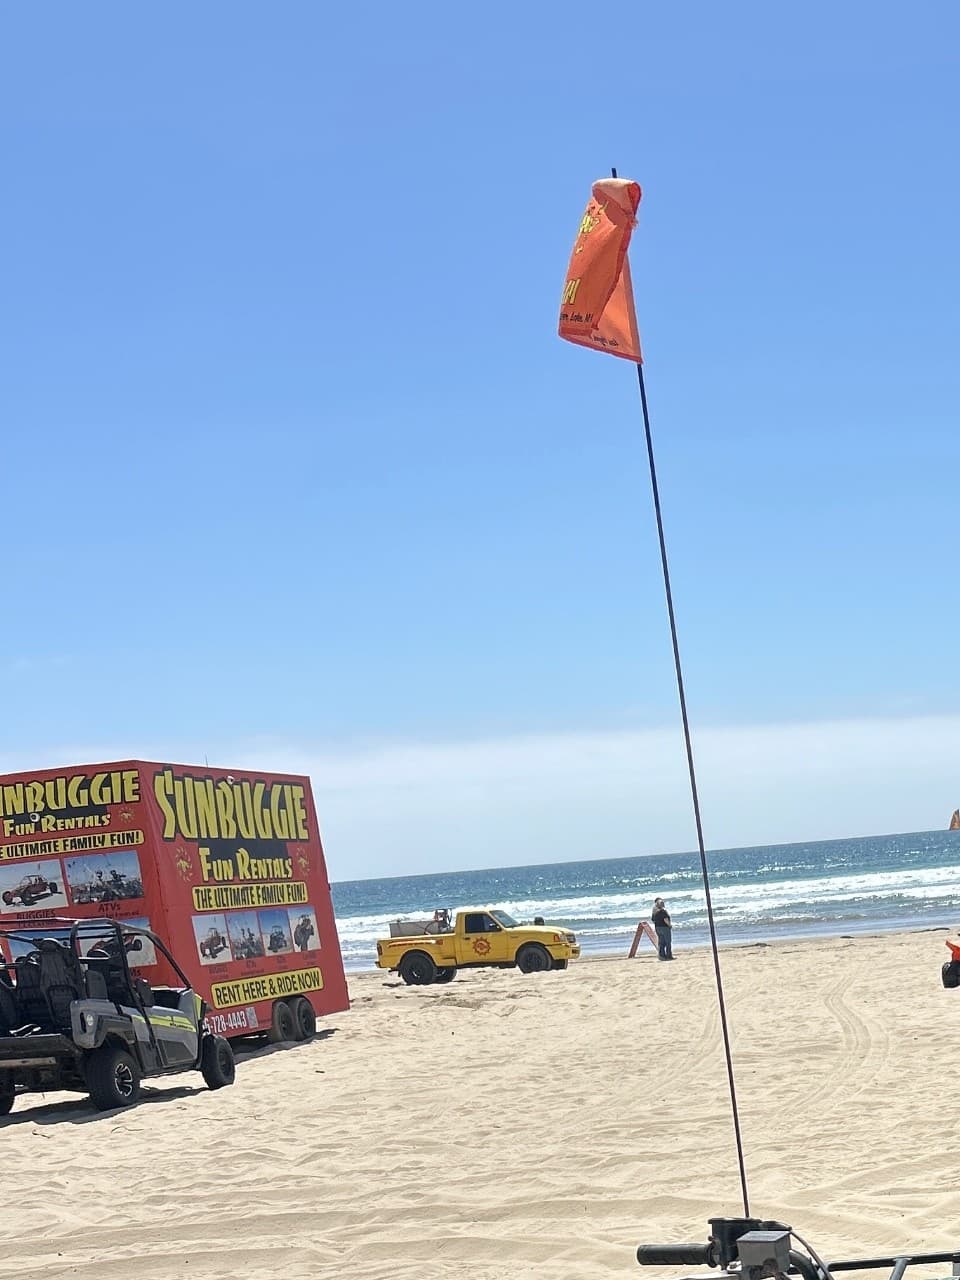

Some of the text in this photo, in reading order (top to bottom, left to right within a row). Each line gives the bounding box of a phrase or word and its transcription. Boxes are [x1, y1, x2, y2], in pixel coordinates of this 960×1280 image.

[0, 770, 140, 816] NBUGGIE
[154, 769, 309, 840] SUNBUGGIE
[7, 840, 60, 858] ULTIMATE
[62, 834, 106, 851] FAMILY
[110, 831, 140, 846] FUN!
[194, 881, 306, 909] THE ULTIMATE FAMILY FUN!
[214, 970, 321, 1006] RENT HERE & RIDE NOW
[202, 1010, 248, 1035] 5-728-4443
